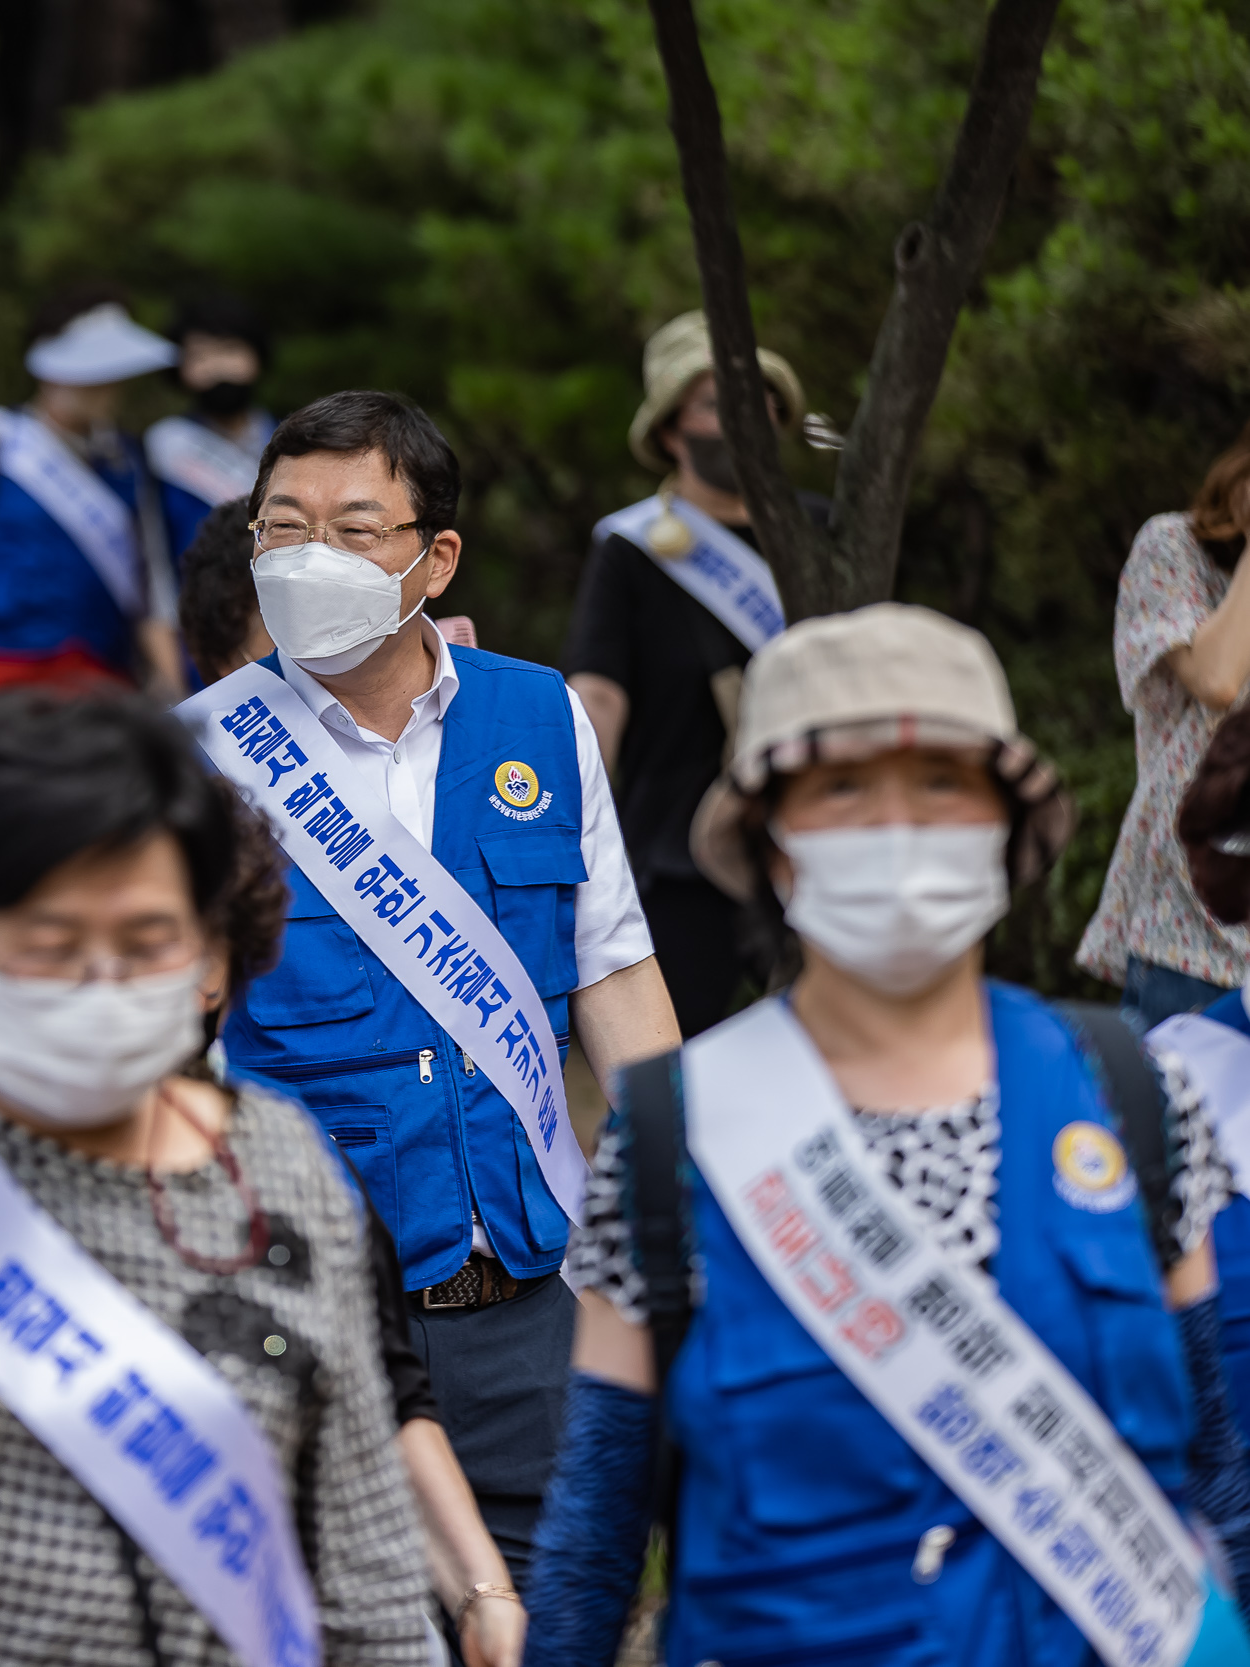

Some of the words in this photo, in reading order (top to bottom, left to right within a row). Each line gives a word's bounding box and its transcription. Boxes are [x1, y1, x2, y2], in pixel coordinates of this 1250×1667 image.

[219, 696, 309, 788] 법질서
[282, 771, 375, 872] 확립을
[353, 853, 427, 927] 위한
[404, 911, 513, 1029] 기초질서
[495, 1008, 549, 1103] 지키기
[536, 1086, 559, 1154] 운동
